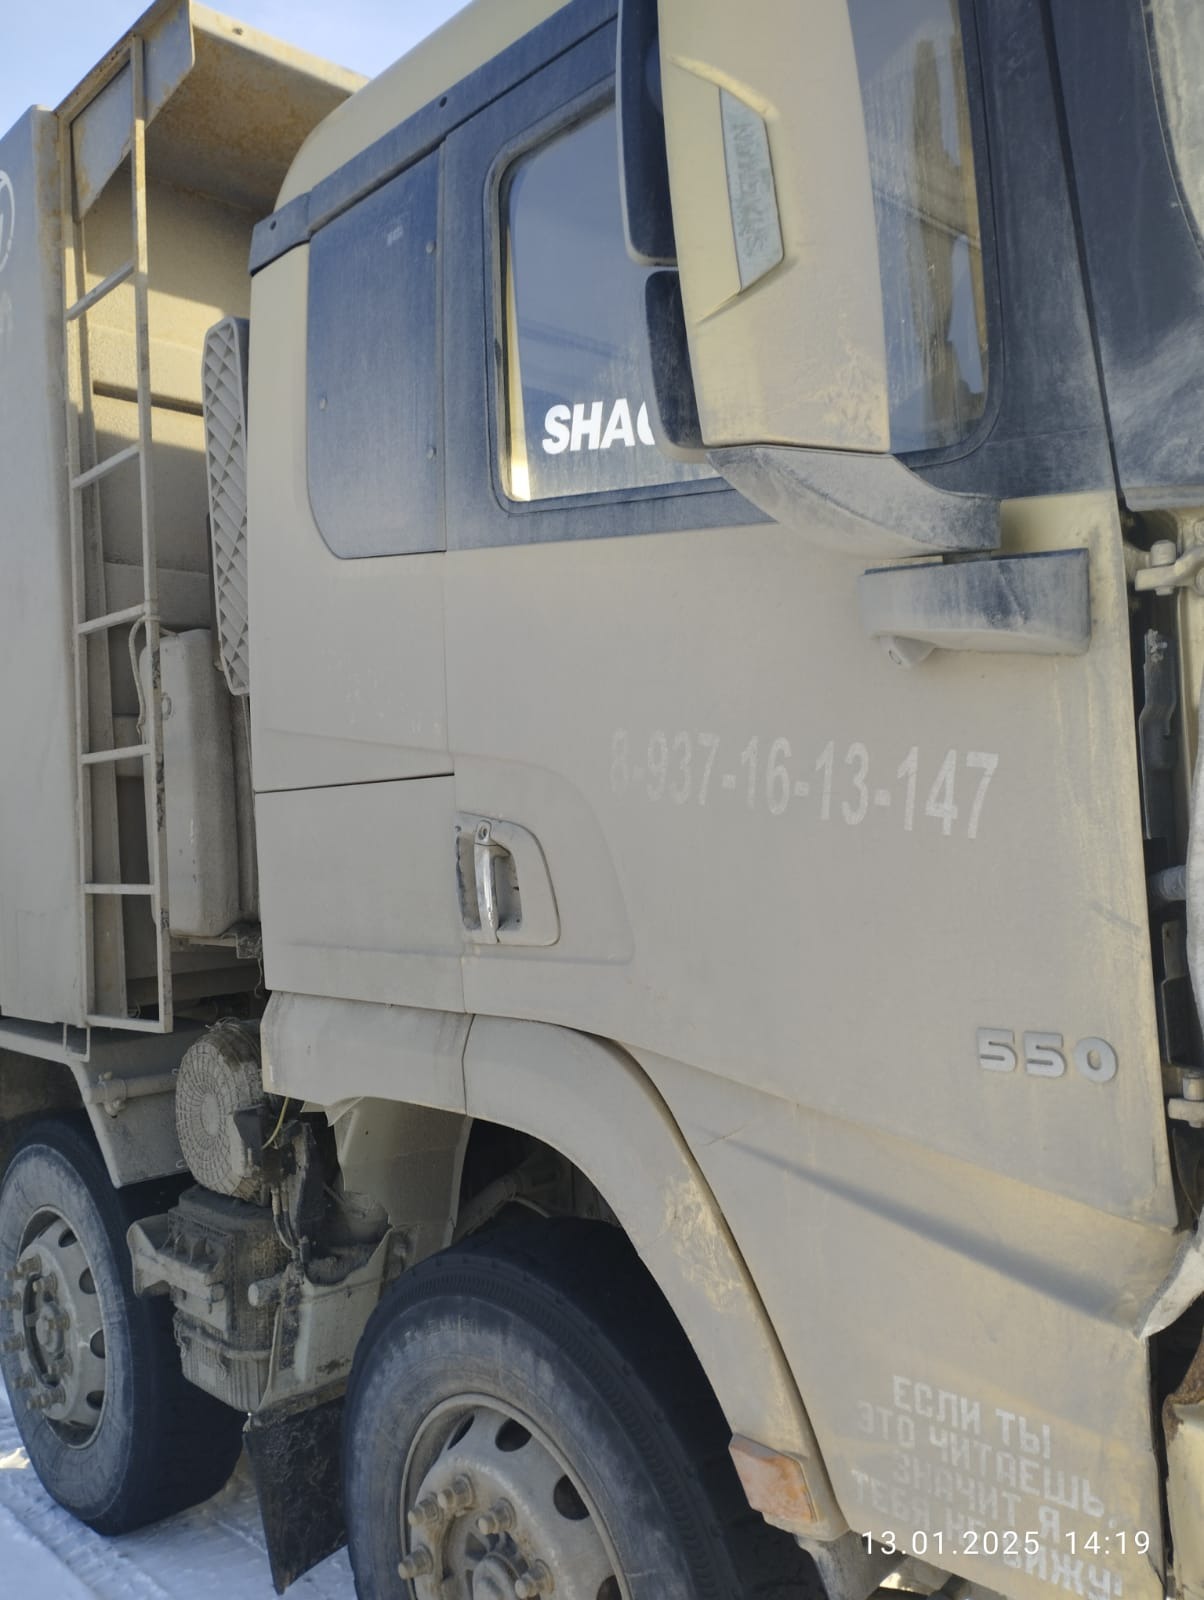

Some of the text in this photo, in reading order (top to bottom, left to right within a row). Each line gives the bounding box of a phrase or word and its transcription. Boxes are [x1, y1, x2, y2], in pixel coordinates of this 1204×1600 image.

[608, 727, 1000, 840] 8-937-16-13-147
[976, 1027, 1118, 1083] 550
[856, 1399, 917, 1449] ЭТО
[892, 1374, 1051, 1460] ЕСЛИ ТЫ
[850, 1466, 931, 1532] ТЕБЯ
[893, 1449, 1061, 1544] ЗНАЧИТ Я
